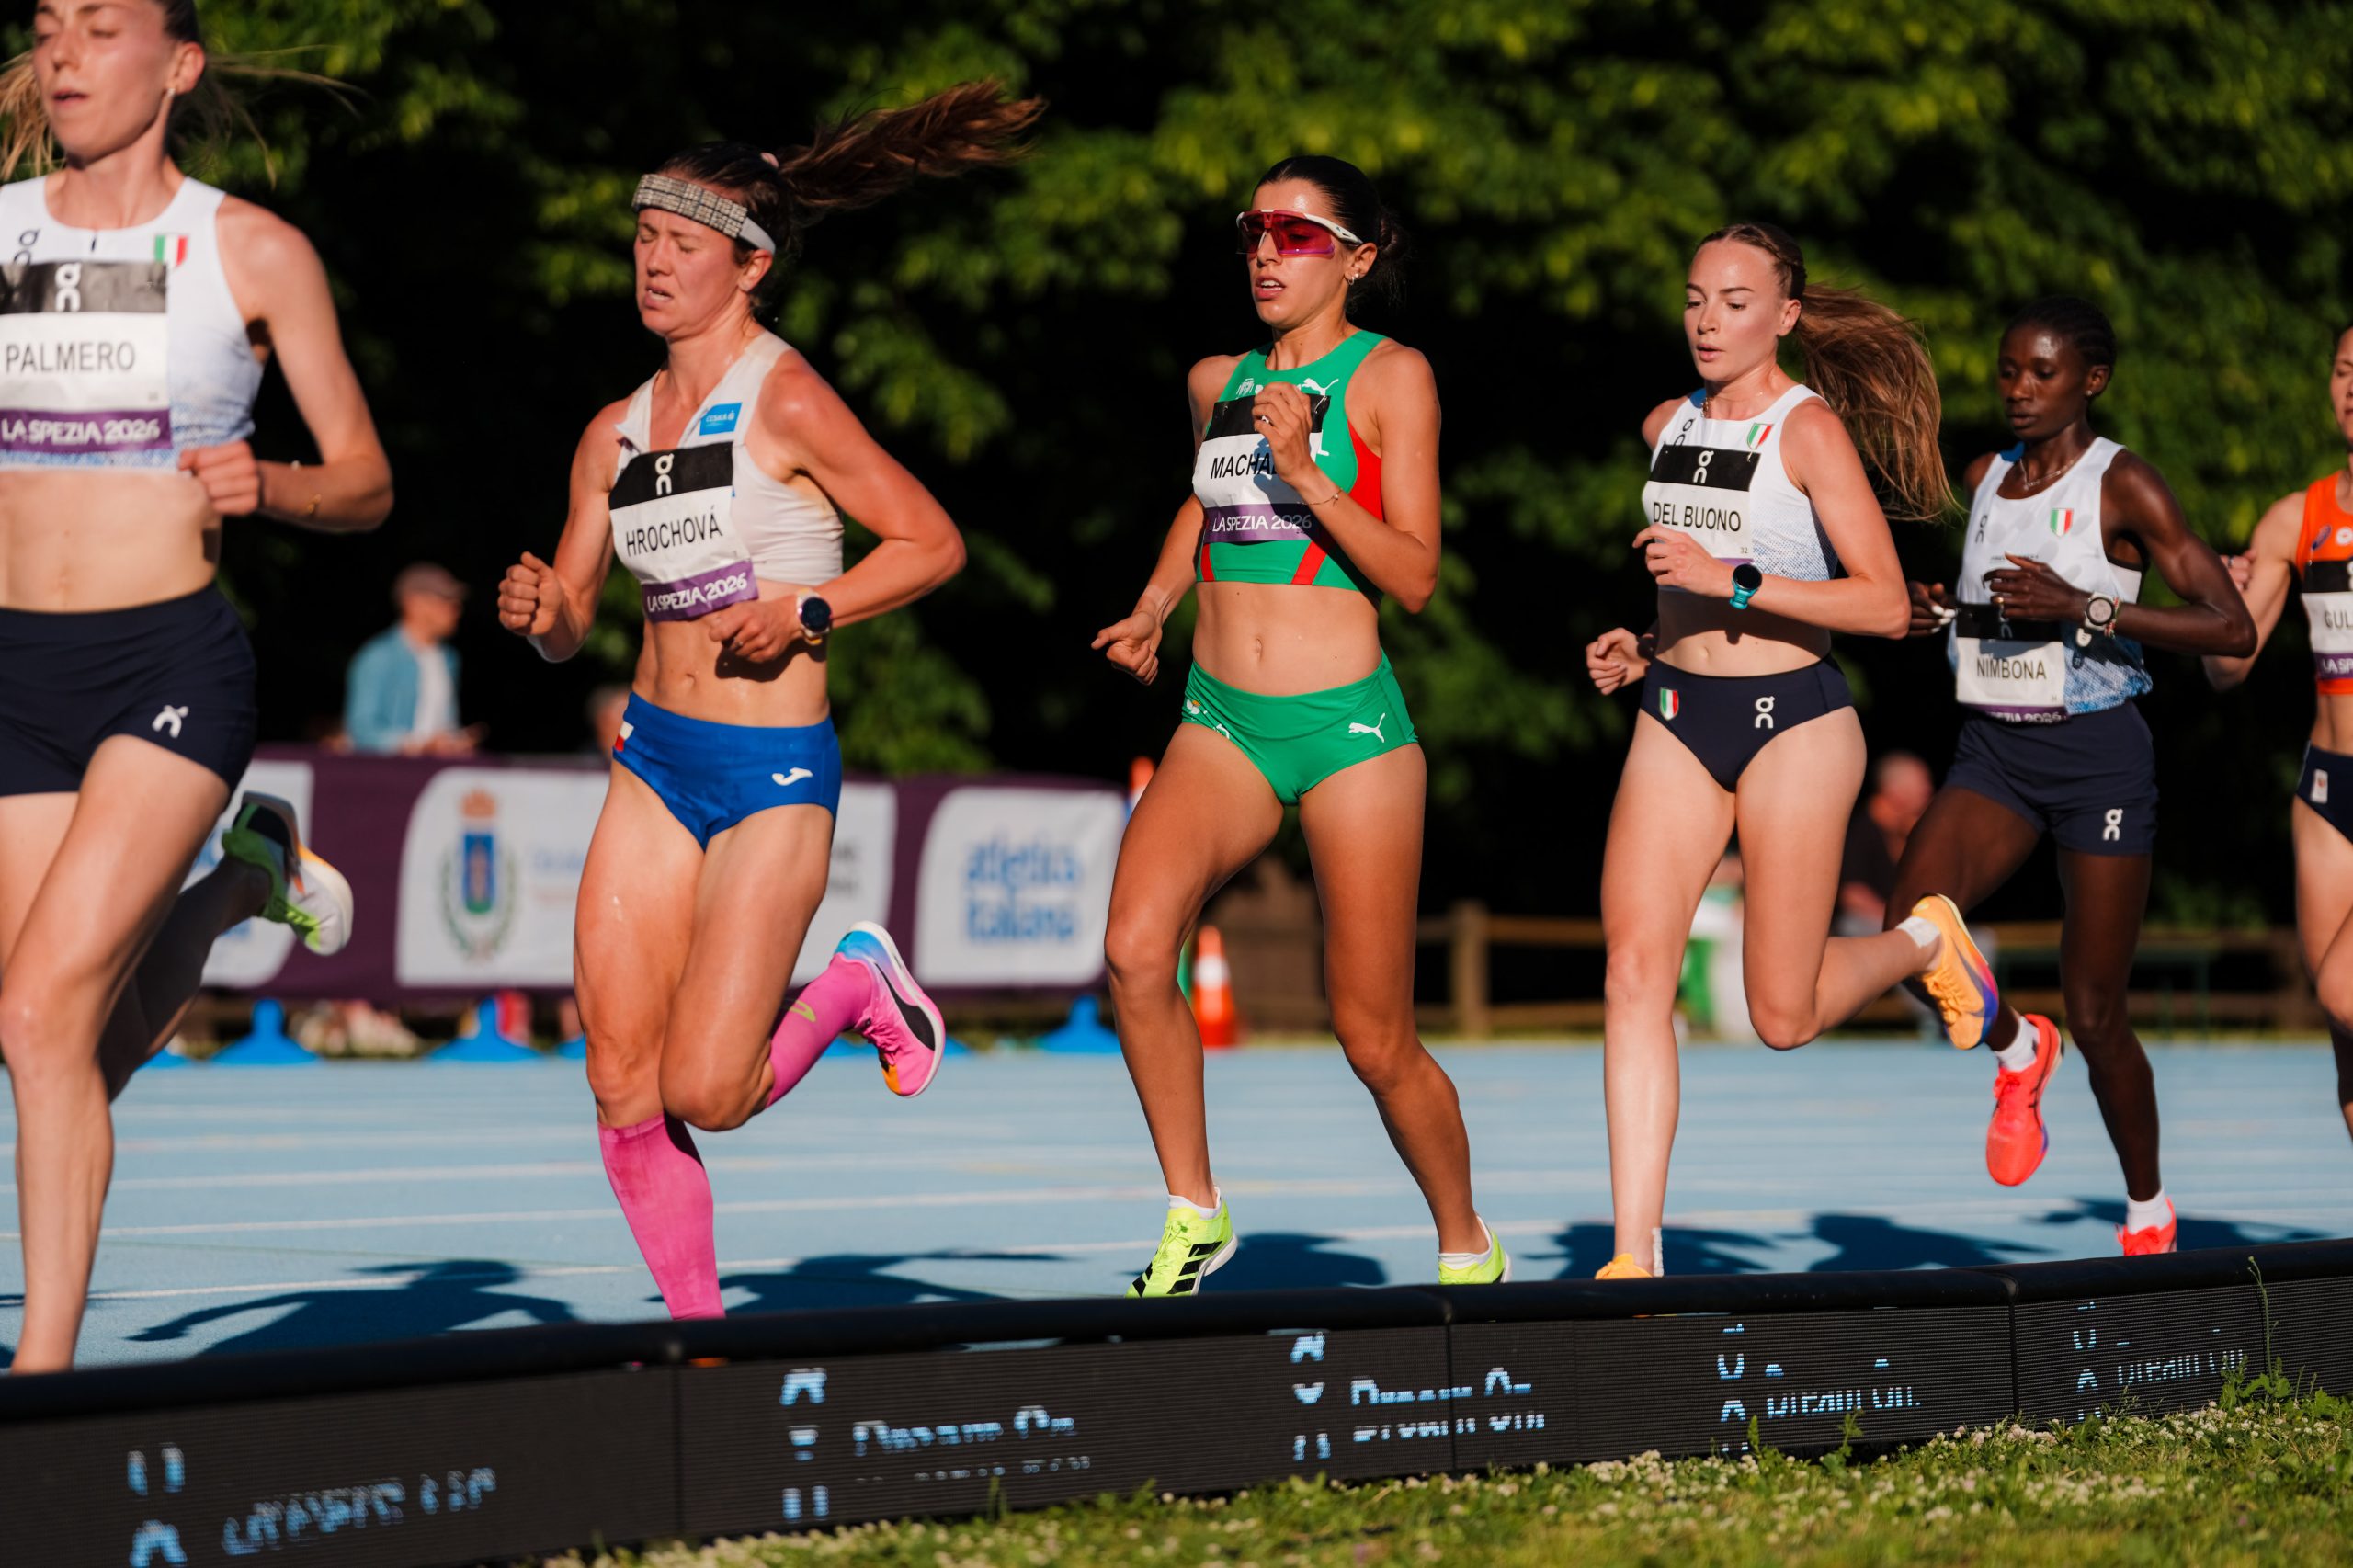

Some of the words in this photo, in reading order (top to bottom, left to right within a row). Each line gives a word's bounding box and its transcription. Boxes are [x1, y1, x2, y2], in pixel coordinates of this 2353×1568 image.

[5, 341, 137, 372] PALMERO
[2, 419, 27, 443] LA
[28, 420, 103, 445] SPEZIA
[104, 418, 161, 444] 2026
[1211, 517, 1226, 532] LA
[1226, 516, 1269, 532] SPEZIA
[1271, 514, 1313, 530] 2026
[1653, 502, 1679, 526] DEL
[1683, 506, 1742, 531] BUONO
[626, 505, 723, 558] HROCHOVÁ
[660, 586, 706, 611] SPEZIA
[704, 571, 748, 601] 2026
[1976, 657, 2047, 680] NIMBONA
